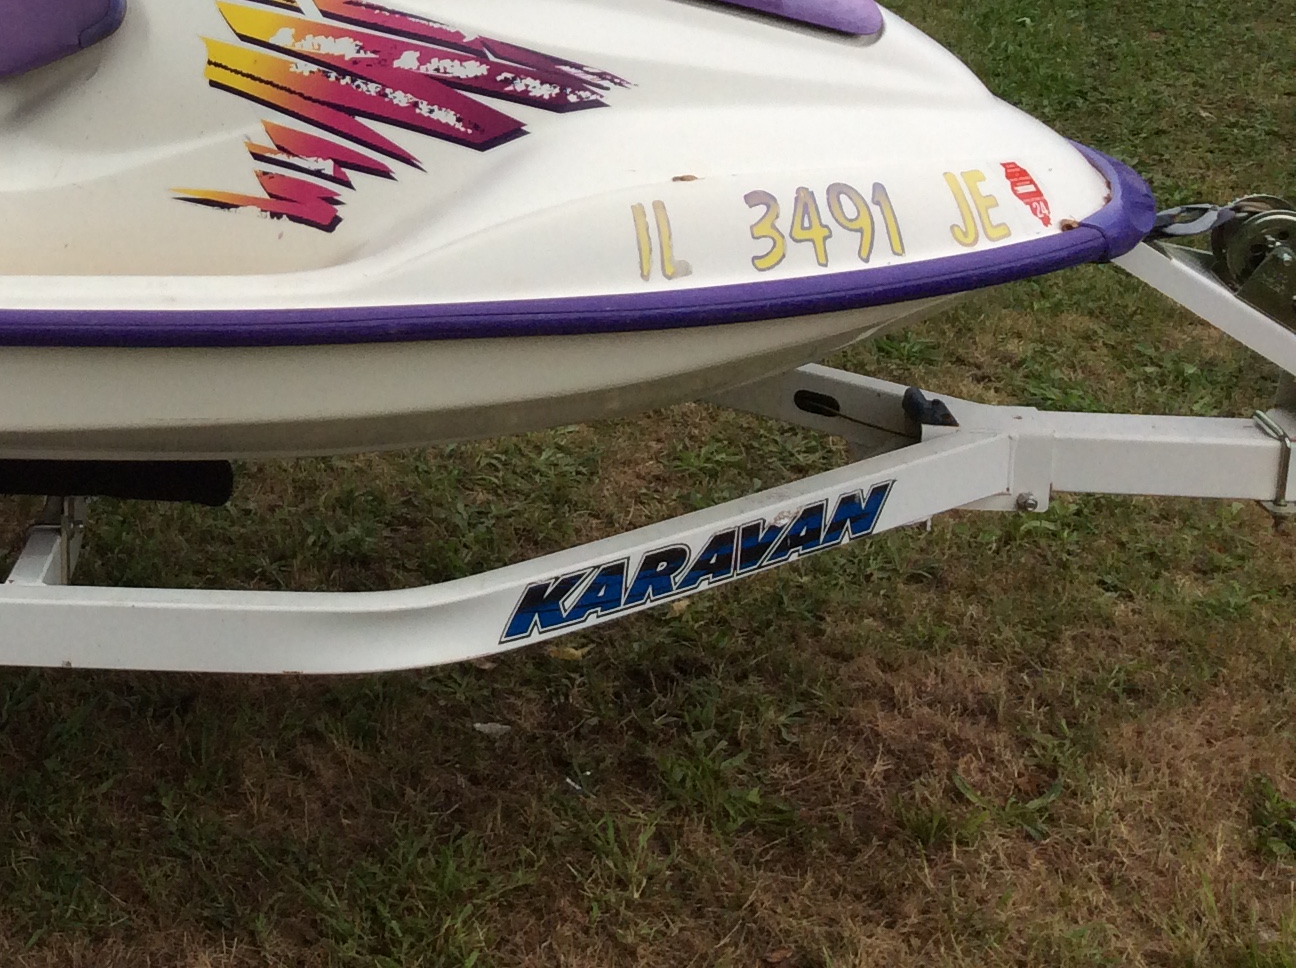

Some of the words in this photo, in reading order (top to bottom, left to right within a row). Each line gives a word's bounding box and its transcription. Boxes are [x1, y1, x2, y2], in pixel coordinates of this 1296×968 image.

[631, 199, 693, 283] IL
[742, 181, 906, 273] 3491
[941, 168, 1012, 247] JE
[499, 479, 896, 644] KARAVAN
